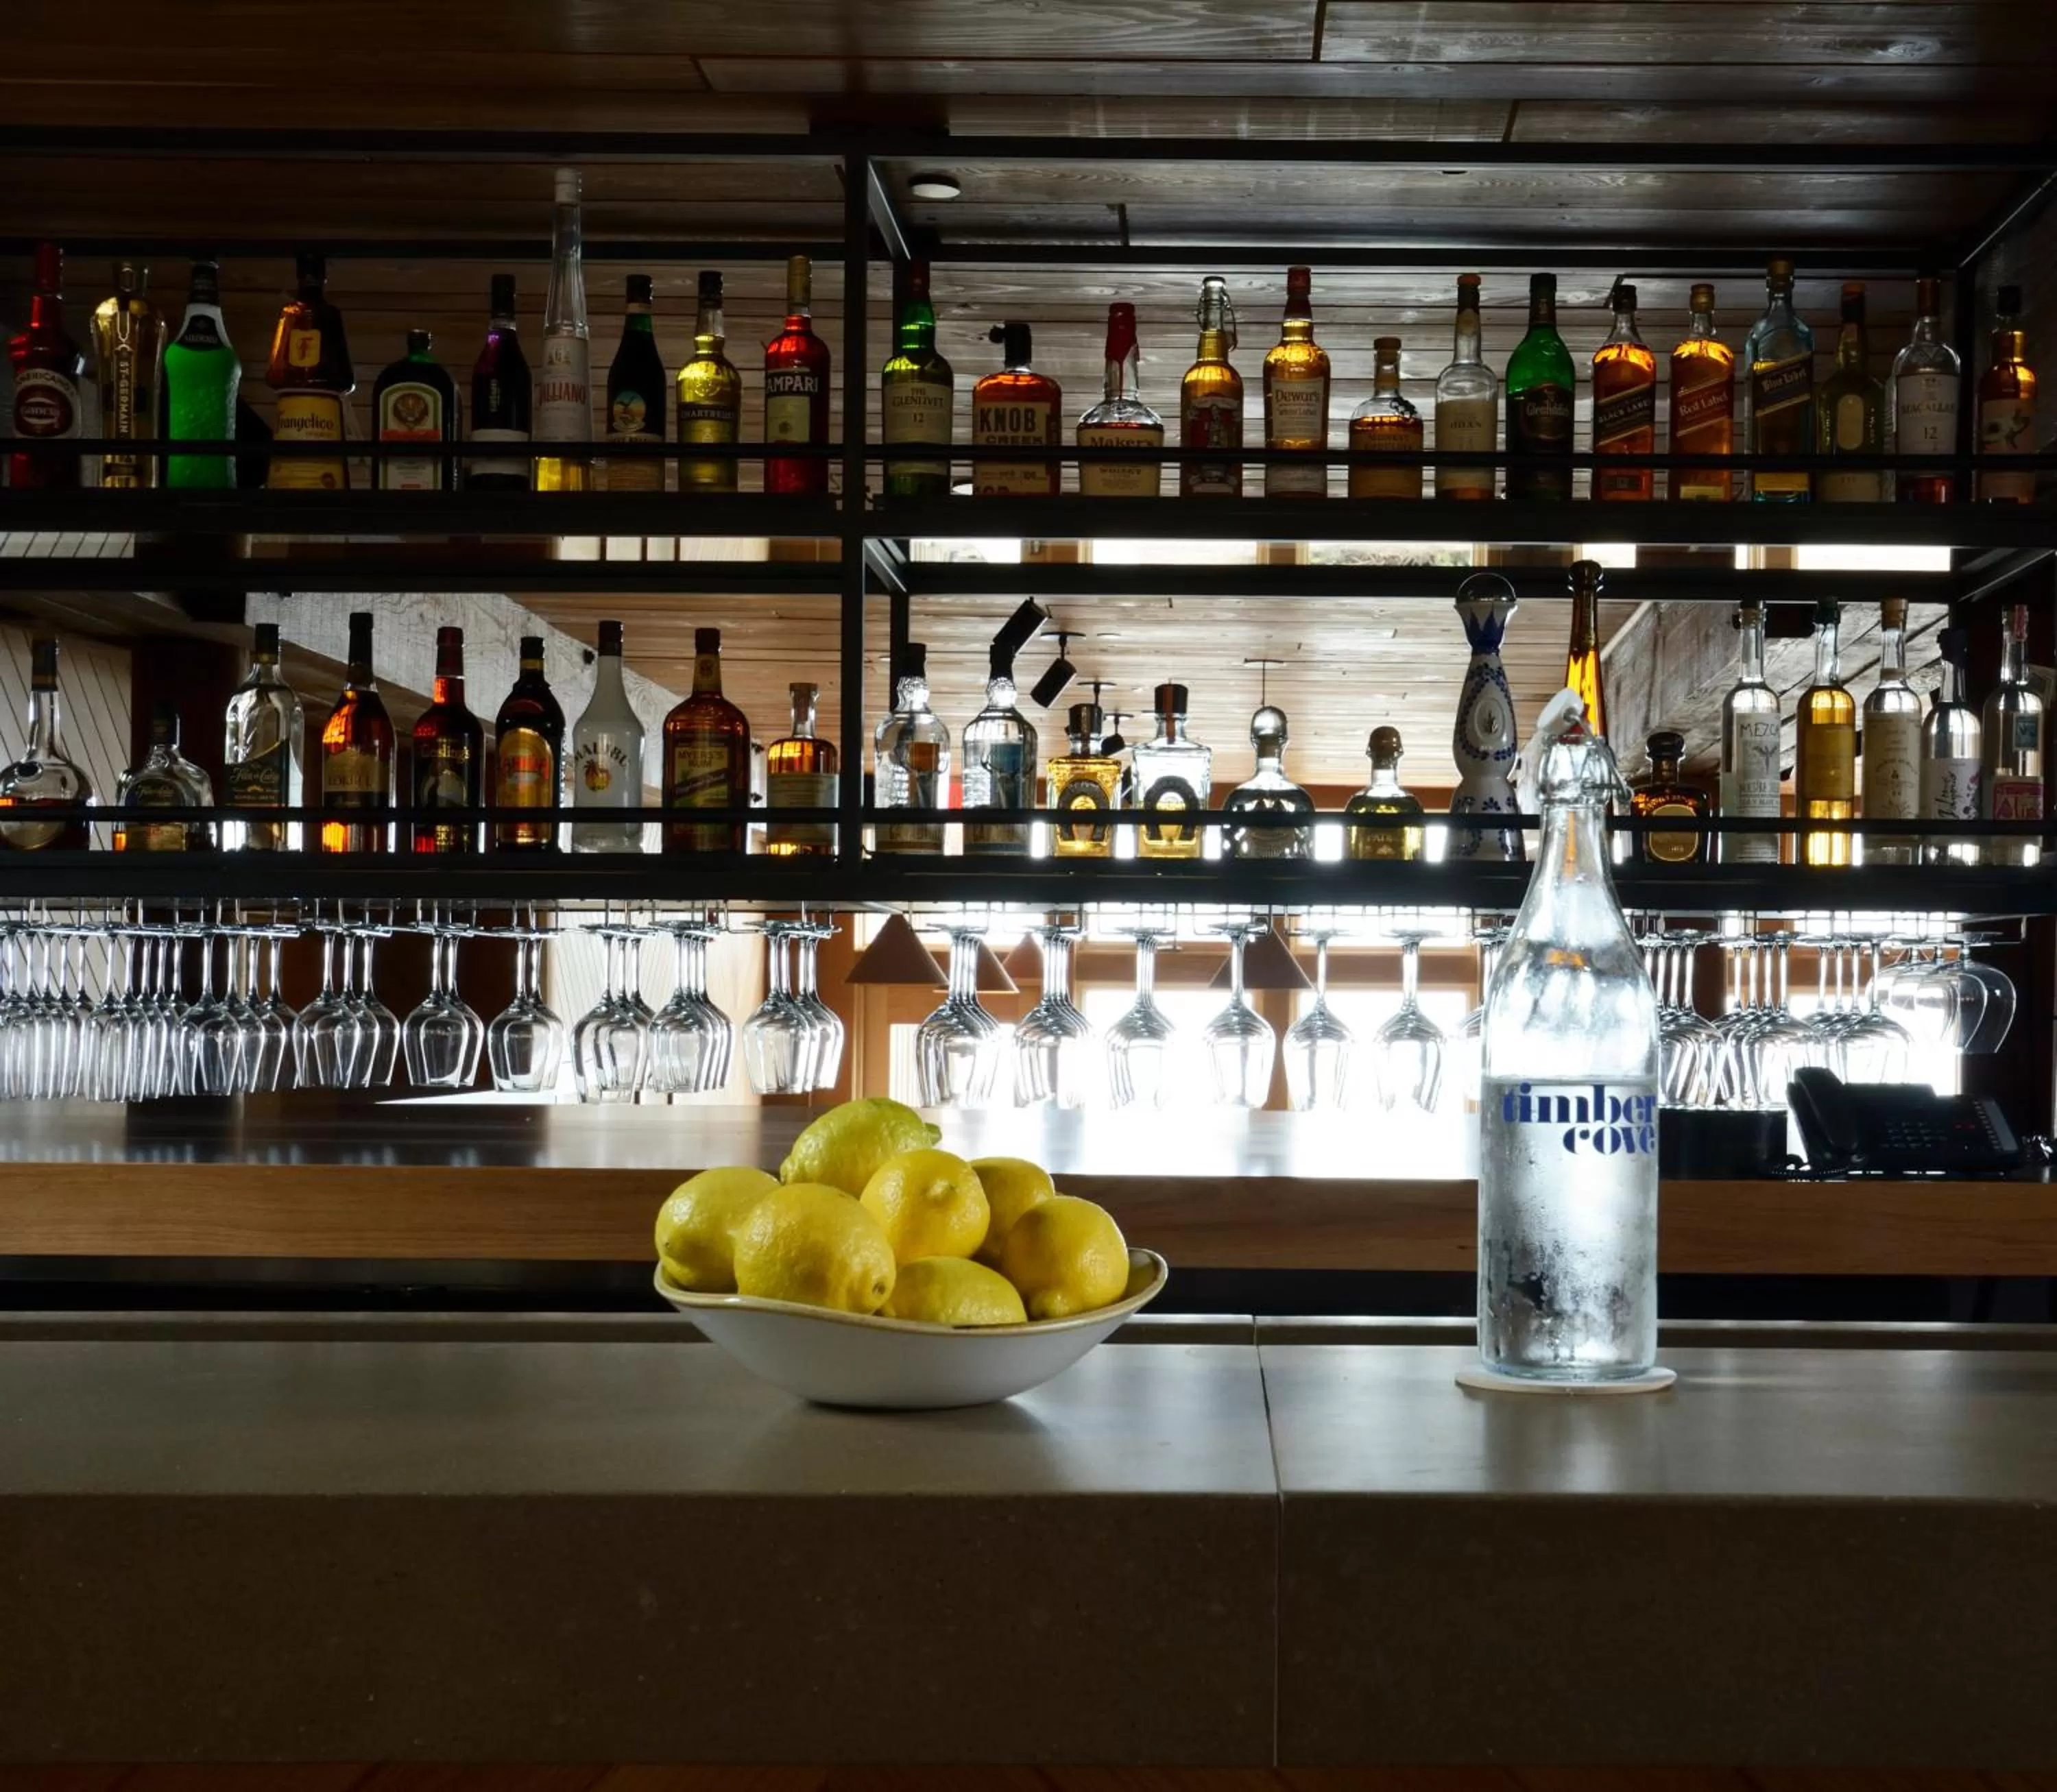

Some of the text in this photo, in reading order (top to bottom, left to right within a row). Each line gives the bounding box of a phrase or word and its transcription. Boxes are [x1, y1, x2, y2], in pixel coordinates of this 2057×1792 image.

[767, 375, 819, 393] AMPARI
[119, 361, 130, 433] ST-GERMAIN
[892, 396, 944, 407] GLENLIVET
[913, 413, 924, 423] 12
[981, 407, 1036, 433] KNOB
[986, 435, 1043, 445] CREEK
[1923, 427, 1938, 439] 12
[1739, 722, 1779, 738] MEZC
[1503, 1082, 1656, 1124] timber
[1563, 1125, 1655, 1154] cove
